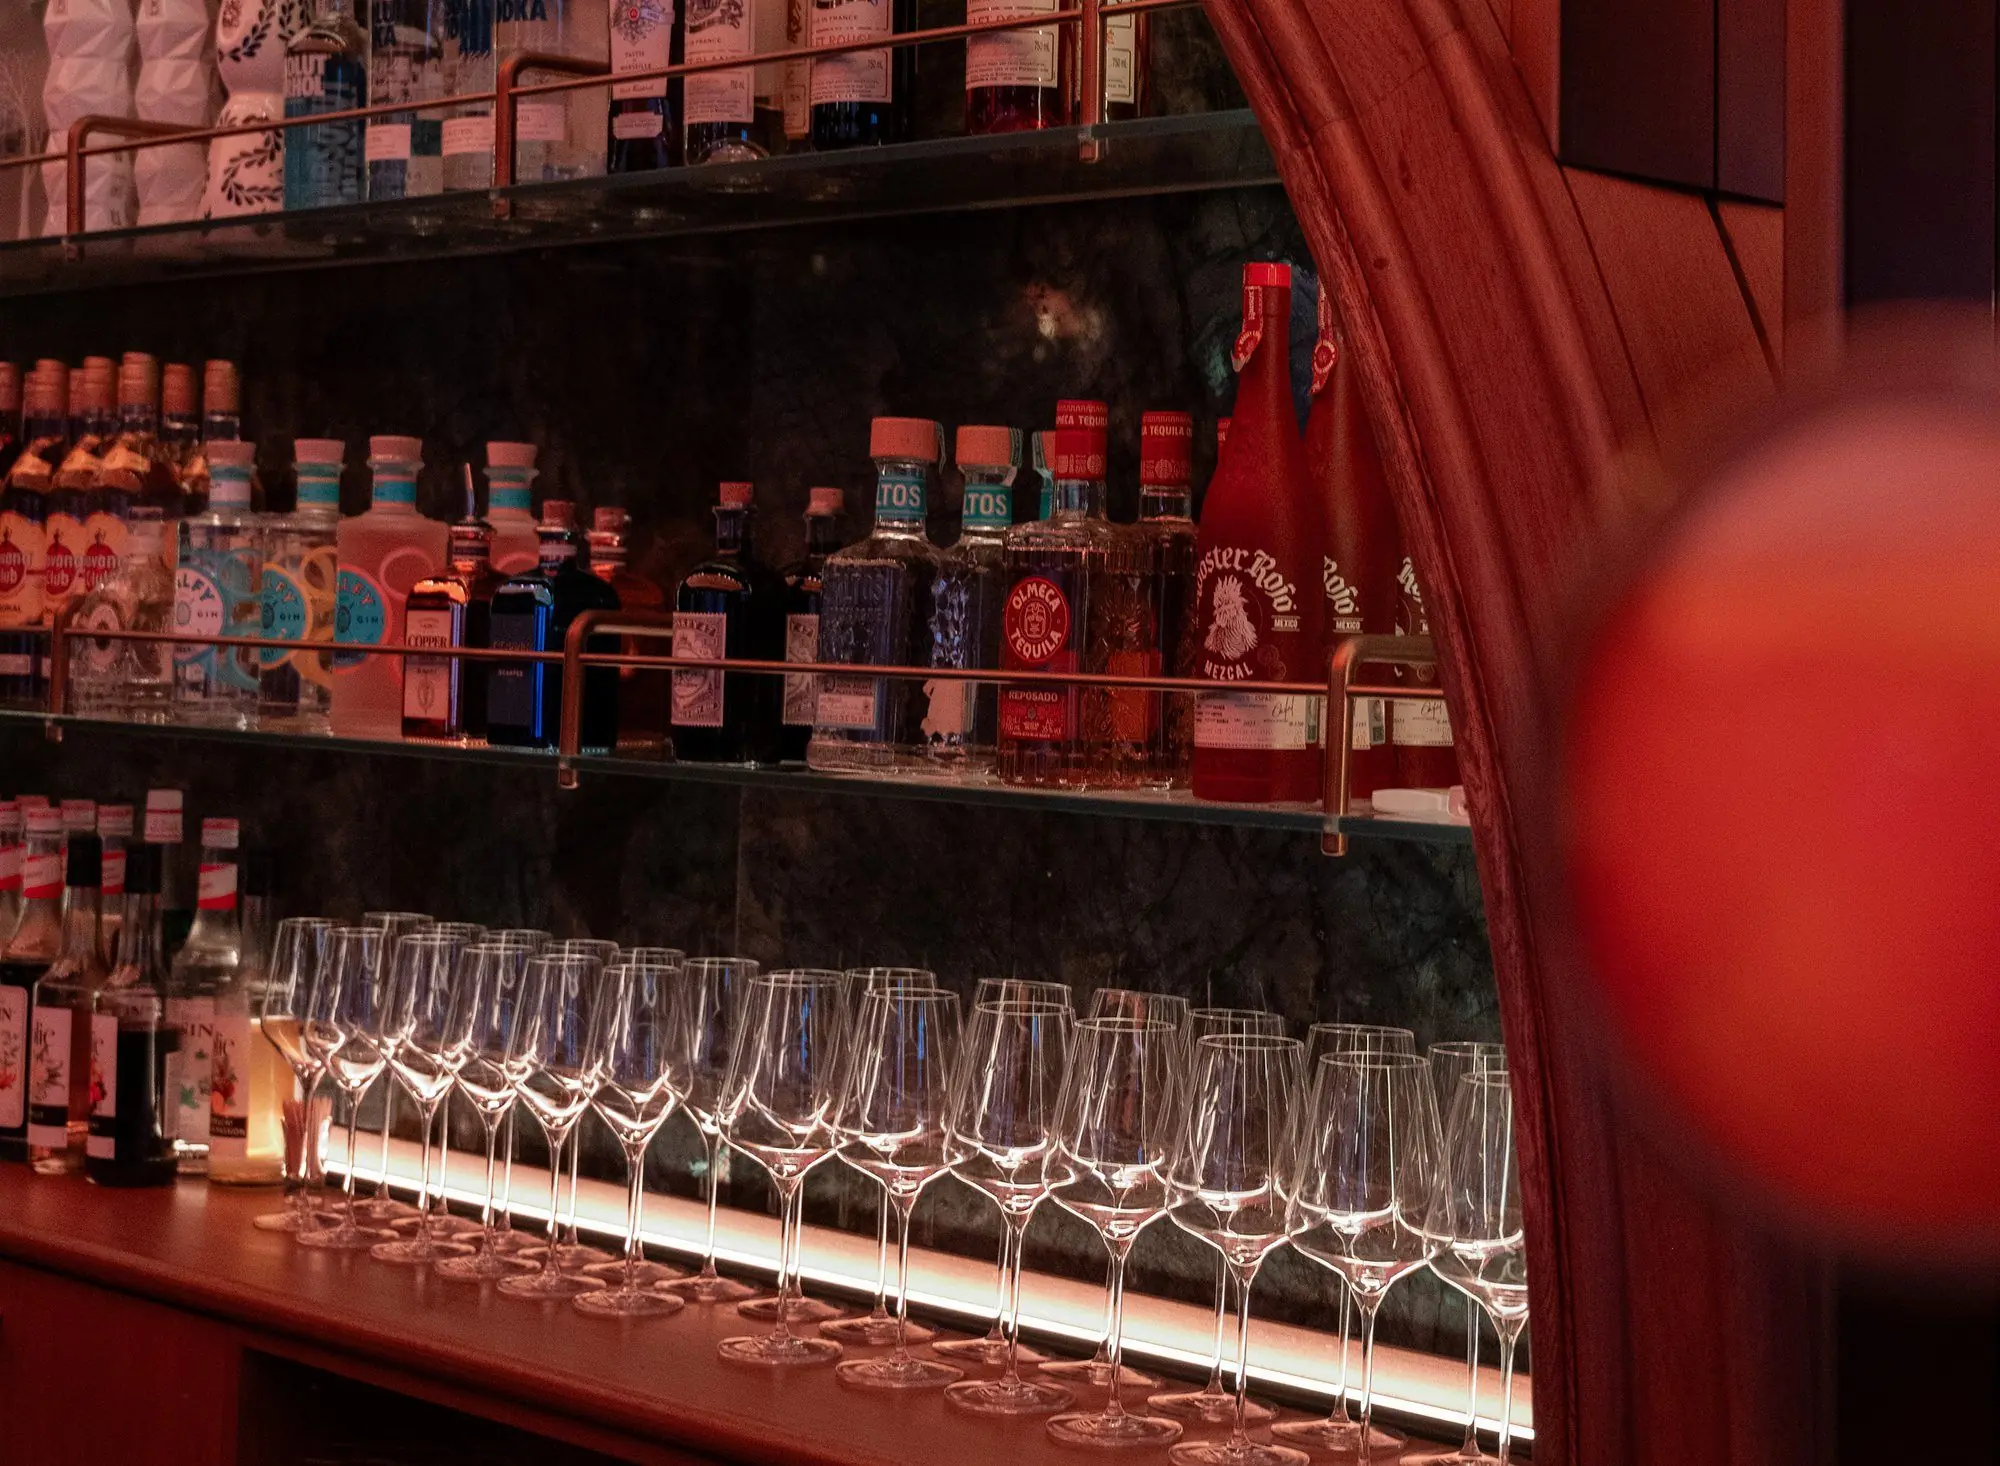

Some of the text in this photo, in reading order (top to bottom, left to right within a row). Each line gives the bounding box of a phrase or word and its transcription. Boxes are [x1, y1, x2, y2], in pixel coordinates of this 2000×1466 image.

[1150, 425, 1185, 437] TEQUILA
[1012, 582, 1061, 613] OLMECA
[197, 611, 218, 619] GIN
[279, 613, 301, 622] GIN
[356, 616, 379, 625] GIN
[1273, 619, 1298, 629] MEXICO
[1335, 621, 1361, 631] MEXICO
[407, 634, 447, 648] COPPER
[1011, 627, 1062, 660] TEQUILA
[1204, 659, 1254, 682] MEZCAL
[1008, 691, 1058, 703] REPOSADO
